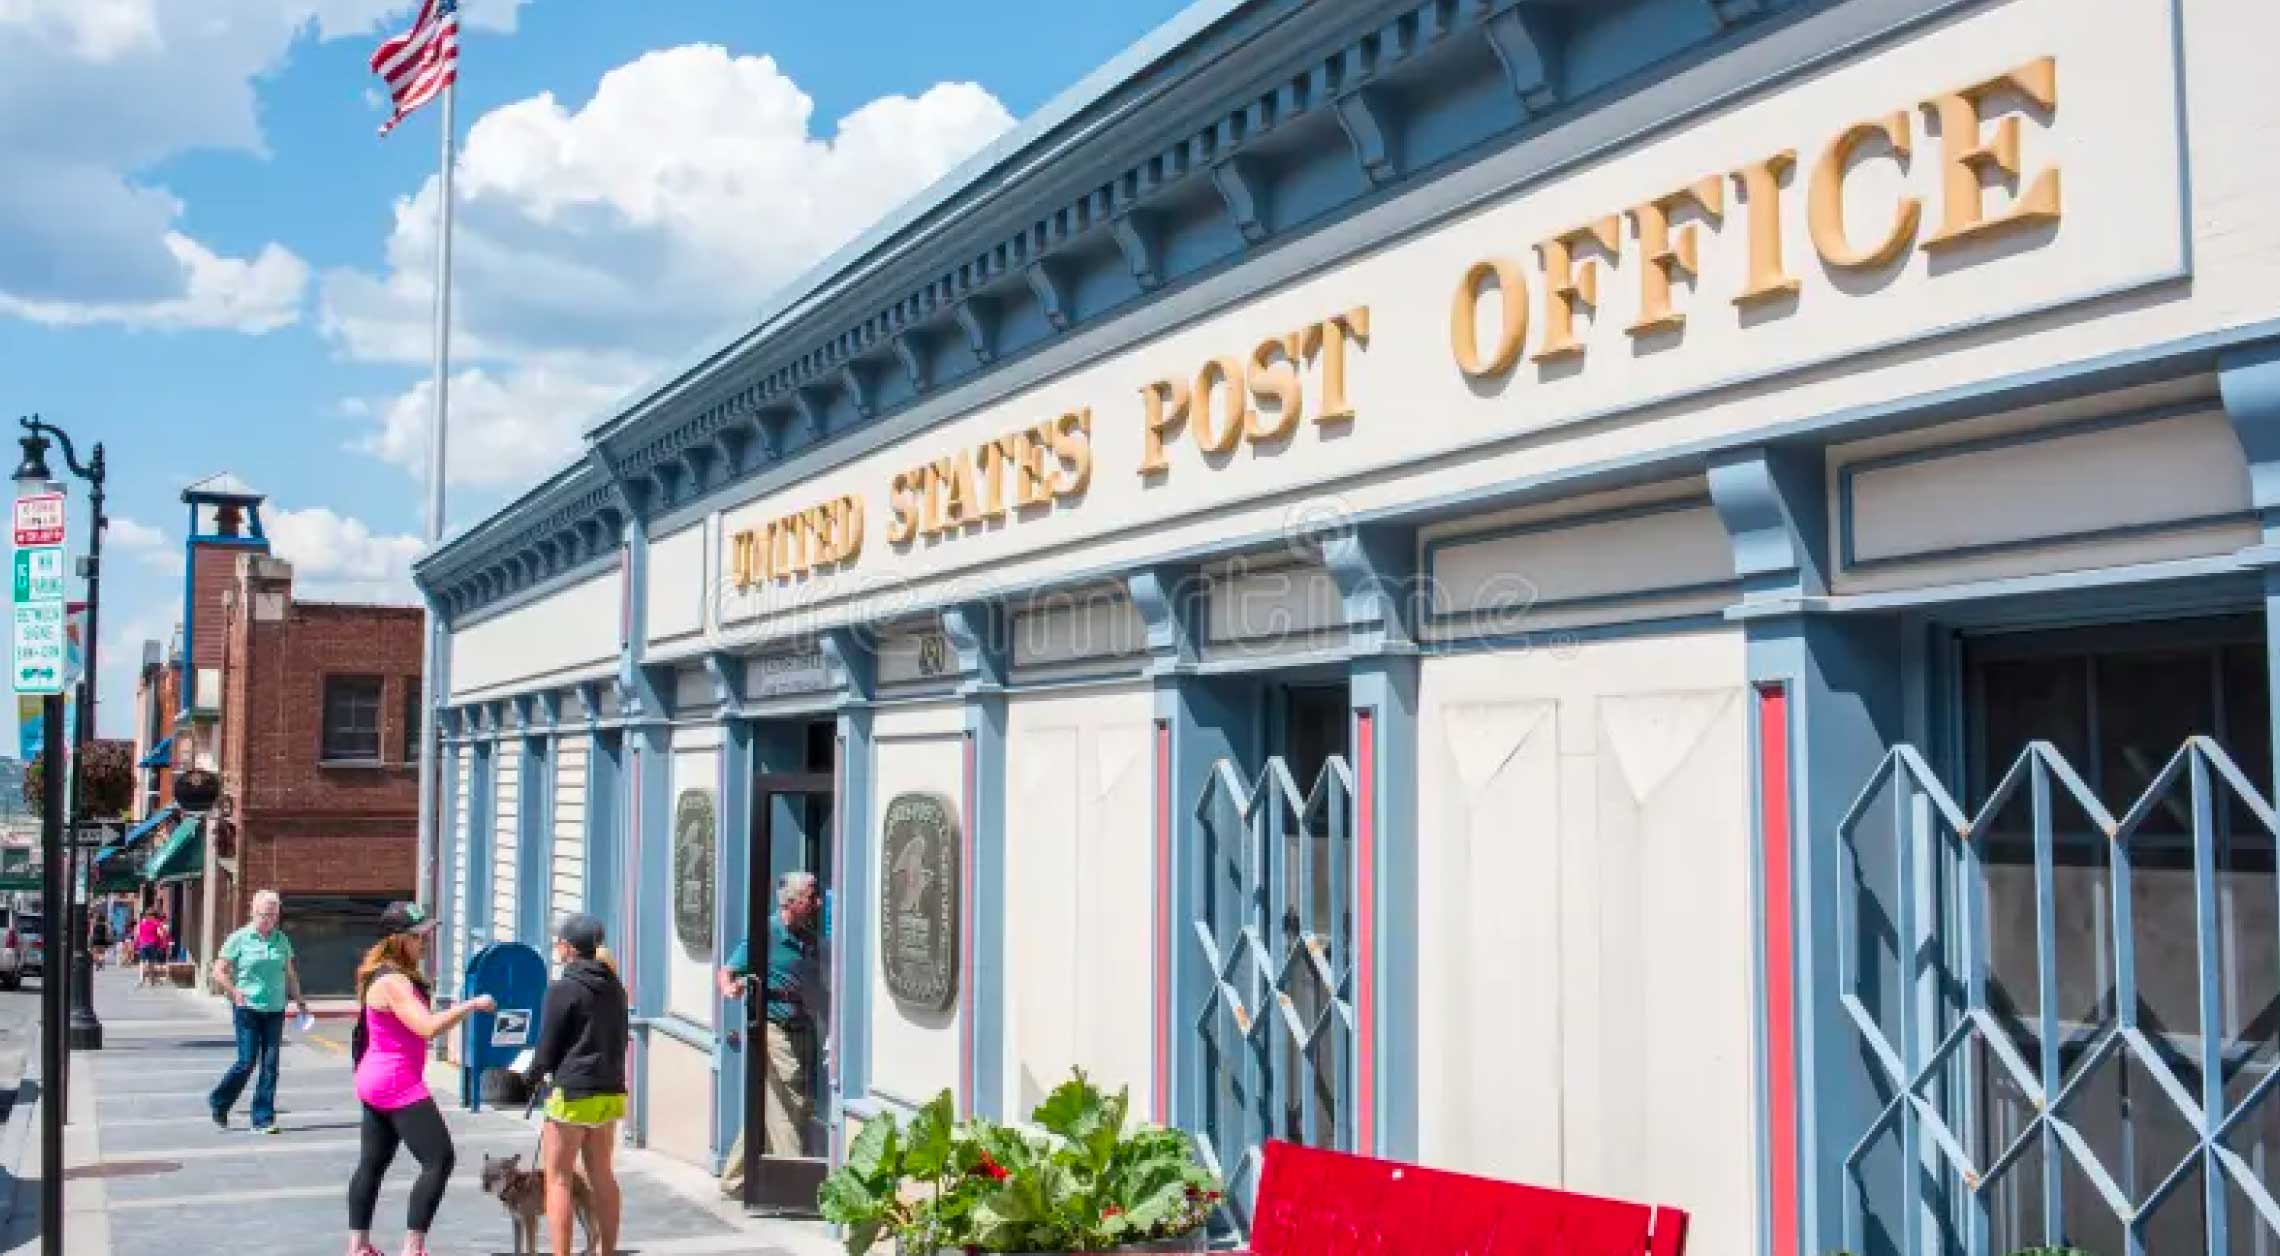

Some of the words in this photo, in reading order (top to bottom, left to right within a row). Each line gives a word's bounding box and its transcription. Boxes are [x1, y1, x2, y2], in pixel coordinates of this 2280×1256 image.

[730, 492, 864, 588] UNITED
[887, 408, 1093, 545] STATES
[1137, 306, 1370, 477] POST
[1450, 55, 2062, 378] OFFICE
